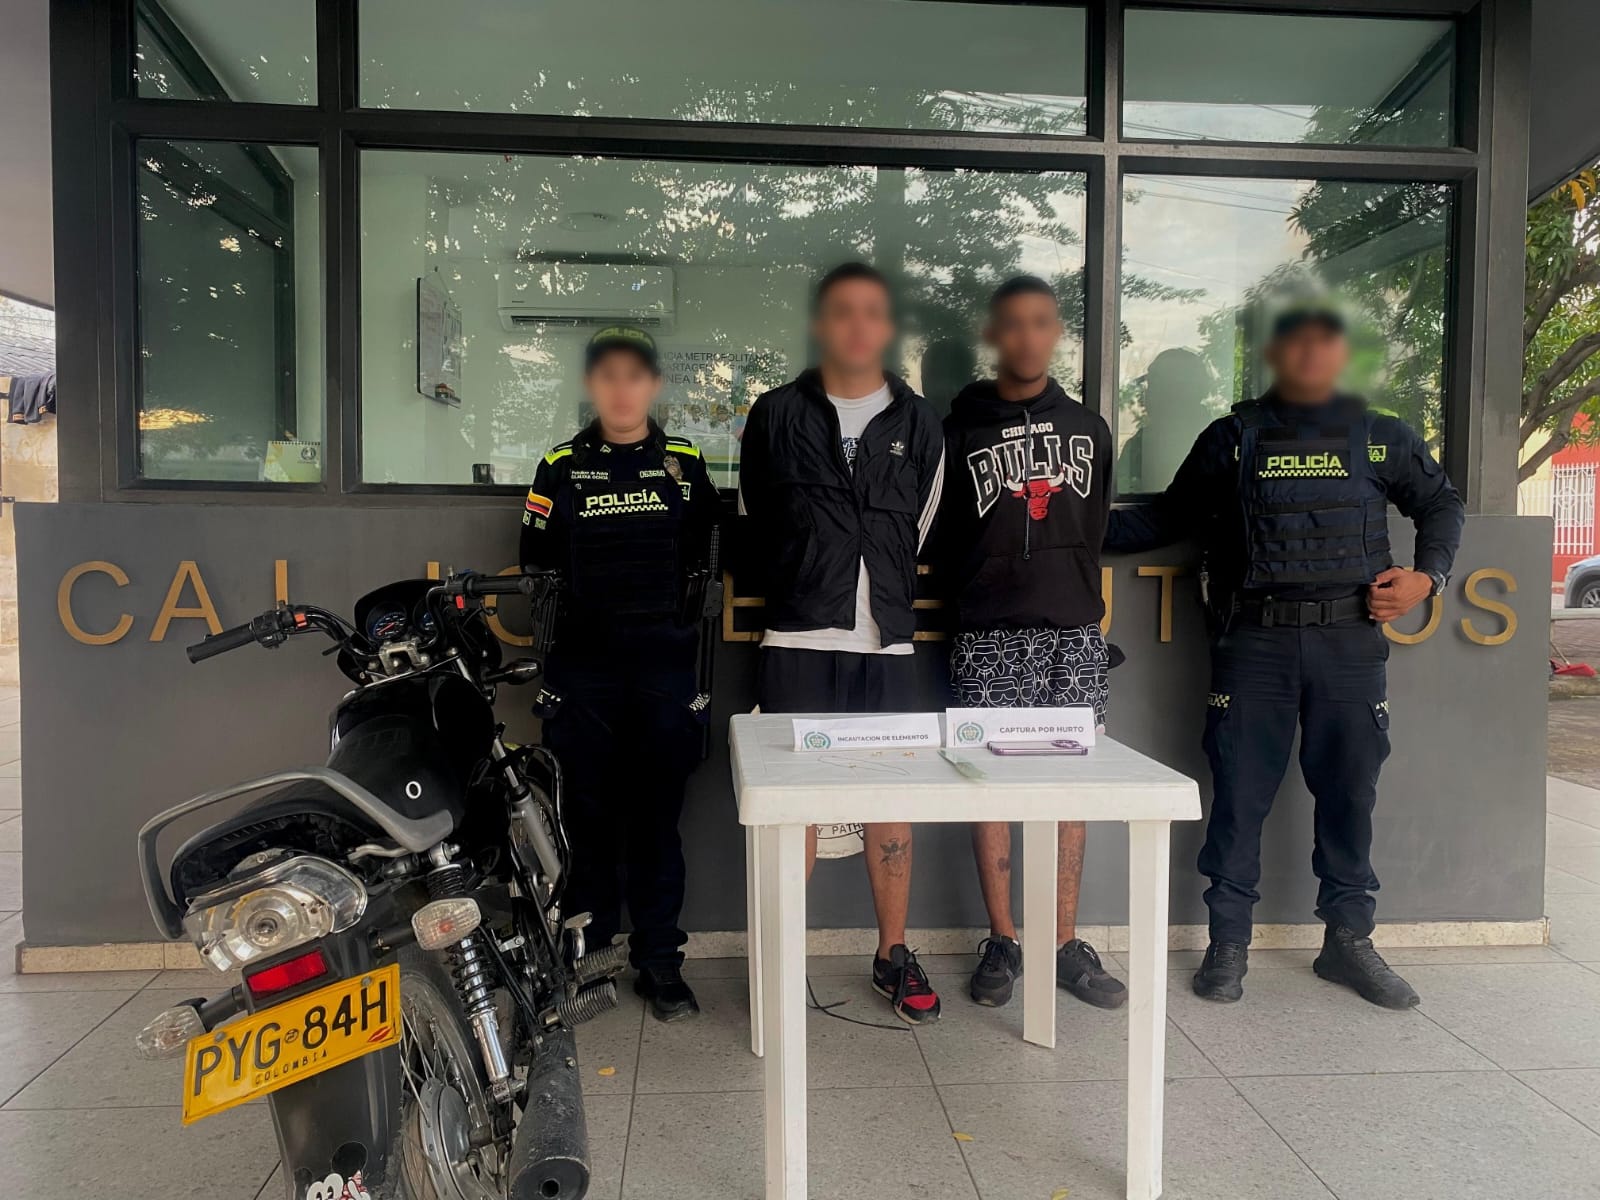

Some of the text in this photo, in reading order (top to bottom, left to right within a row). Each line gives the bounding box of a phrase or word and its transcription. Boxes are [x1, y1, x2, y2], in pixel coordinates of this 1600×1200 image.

[967, 435, 1094, 518] BULLS
[1267, 452, 1342, 470] POLICÍA
[585, 488, 661, 509] POLICÍA
[194, 980, 388, 1097] PYG 84H
[255, 1049, 328, 1085] COLOMBIA
